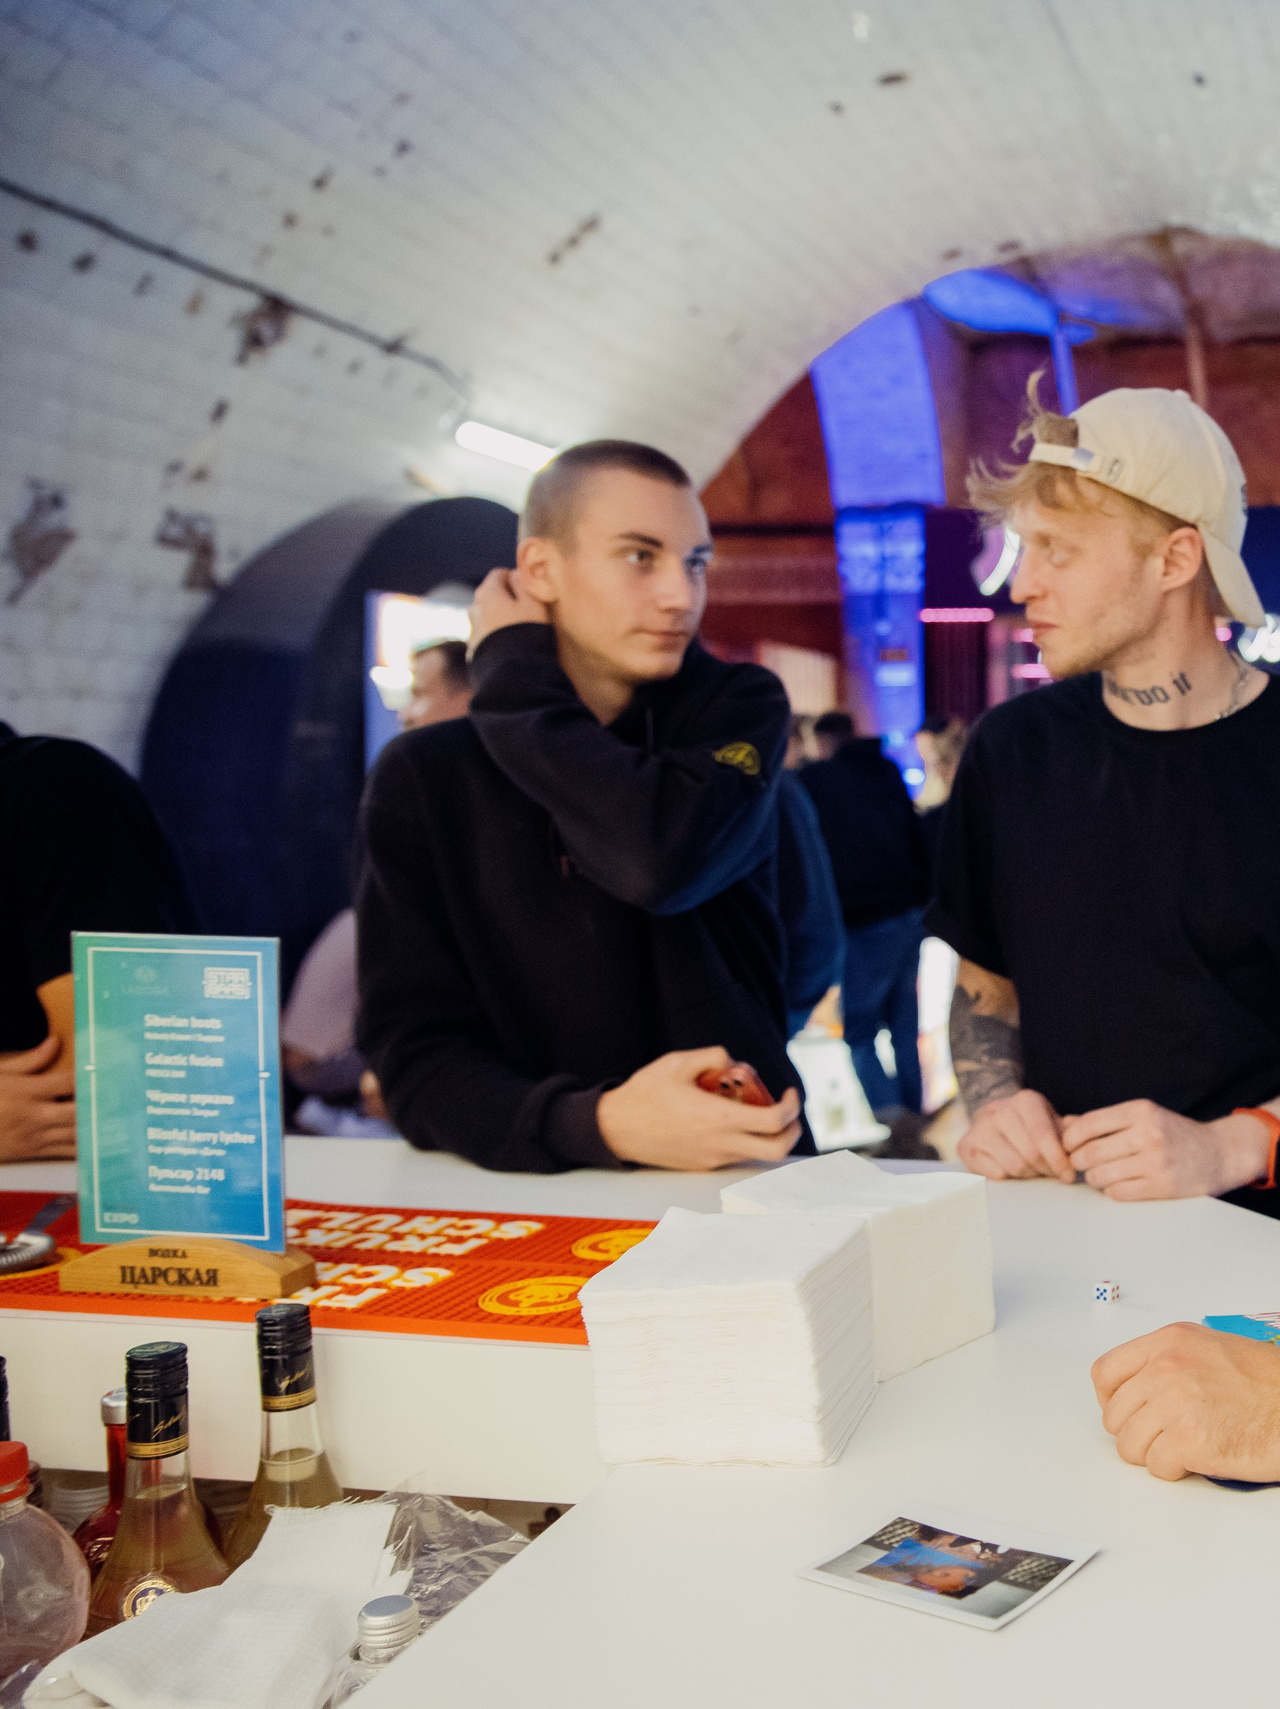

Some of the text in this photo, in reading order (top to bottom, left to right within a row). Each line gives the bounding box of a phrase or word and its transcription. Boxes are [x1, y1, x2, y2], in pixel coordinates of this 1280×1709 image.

[103, 1211, 139, 1224] EXPO
[284, 1228, 490, 1255] FRUK
[148, 1247, 188, 1259] ВОДКА
[119, 1264, 220, 1289] ЦАРСКАЯ
